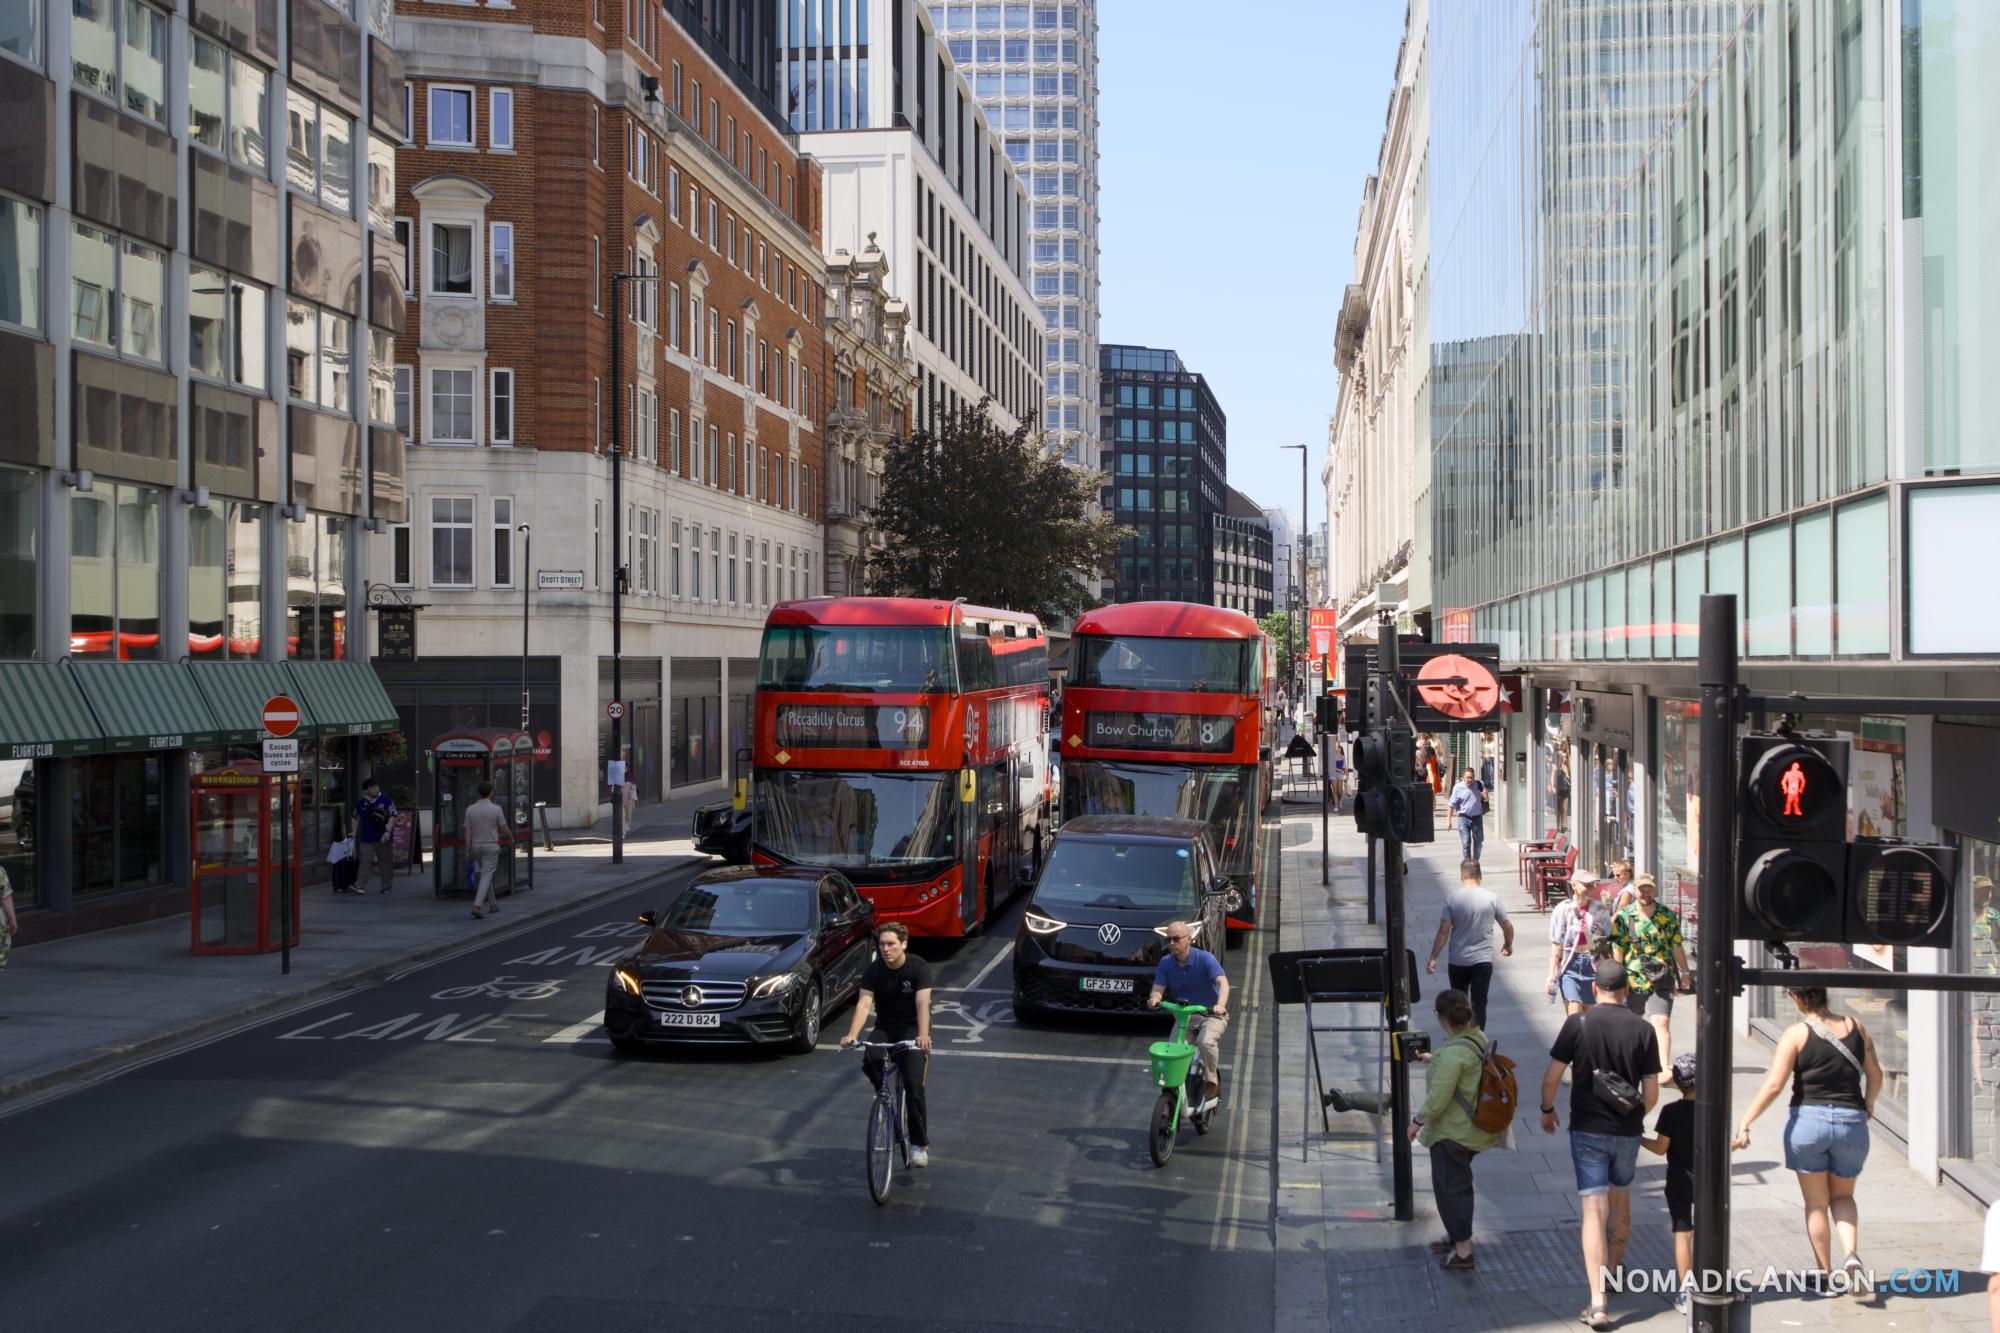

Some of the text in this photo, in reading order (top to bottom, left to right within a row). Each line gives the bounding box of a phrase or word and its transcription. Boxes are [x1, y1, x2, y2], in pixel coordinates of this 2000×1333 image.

[610, 706, 622, 714] 20
[788, 711, 865, 730] Piccadilly Circus
[894, 710, 923, 733] 94
[349, 723, 372, 734] FLIGHT CLUB
[1097, 723, 1173, 738] Bow Church
[1201, 723, 1214, 744] 8
[149, 736, 183, 748] FLIGHT CLUB
[12, 744, 53, 758] FLIGHT CLUB
[206, 776, 257, 784] TELEPHONE
[1085, 978, 1133, 990] GF25 ZXP
[664, 1014, 717, 1025] 222 D 824
[275, 1012, 549, 1042] LANE
